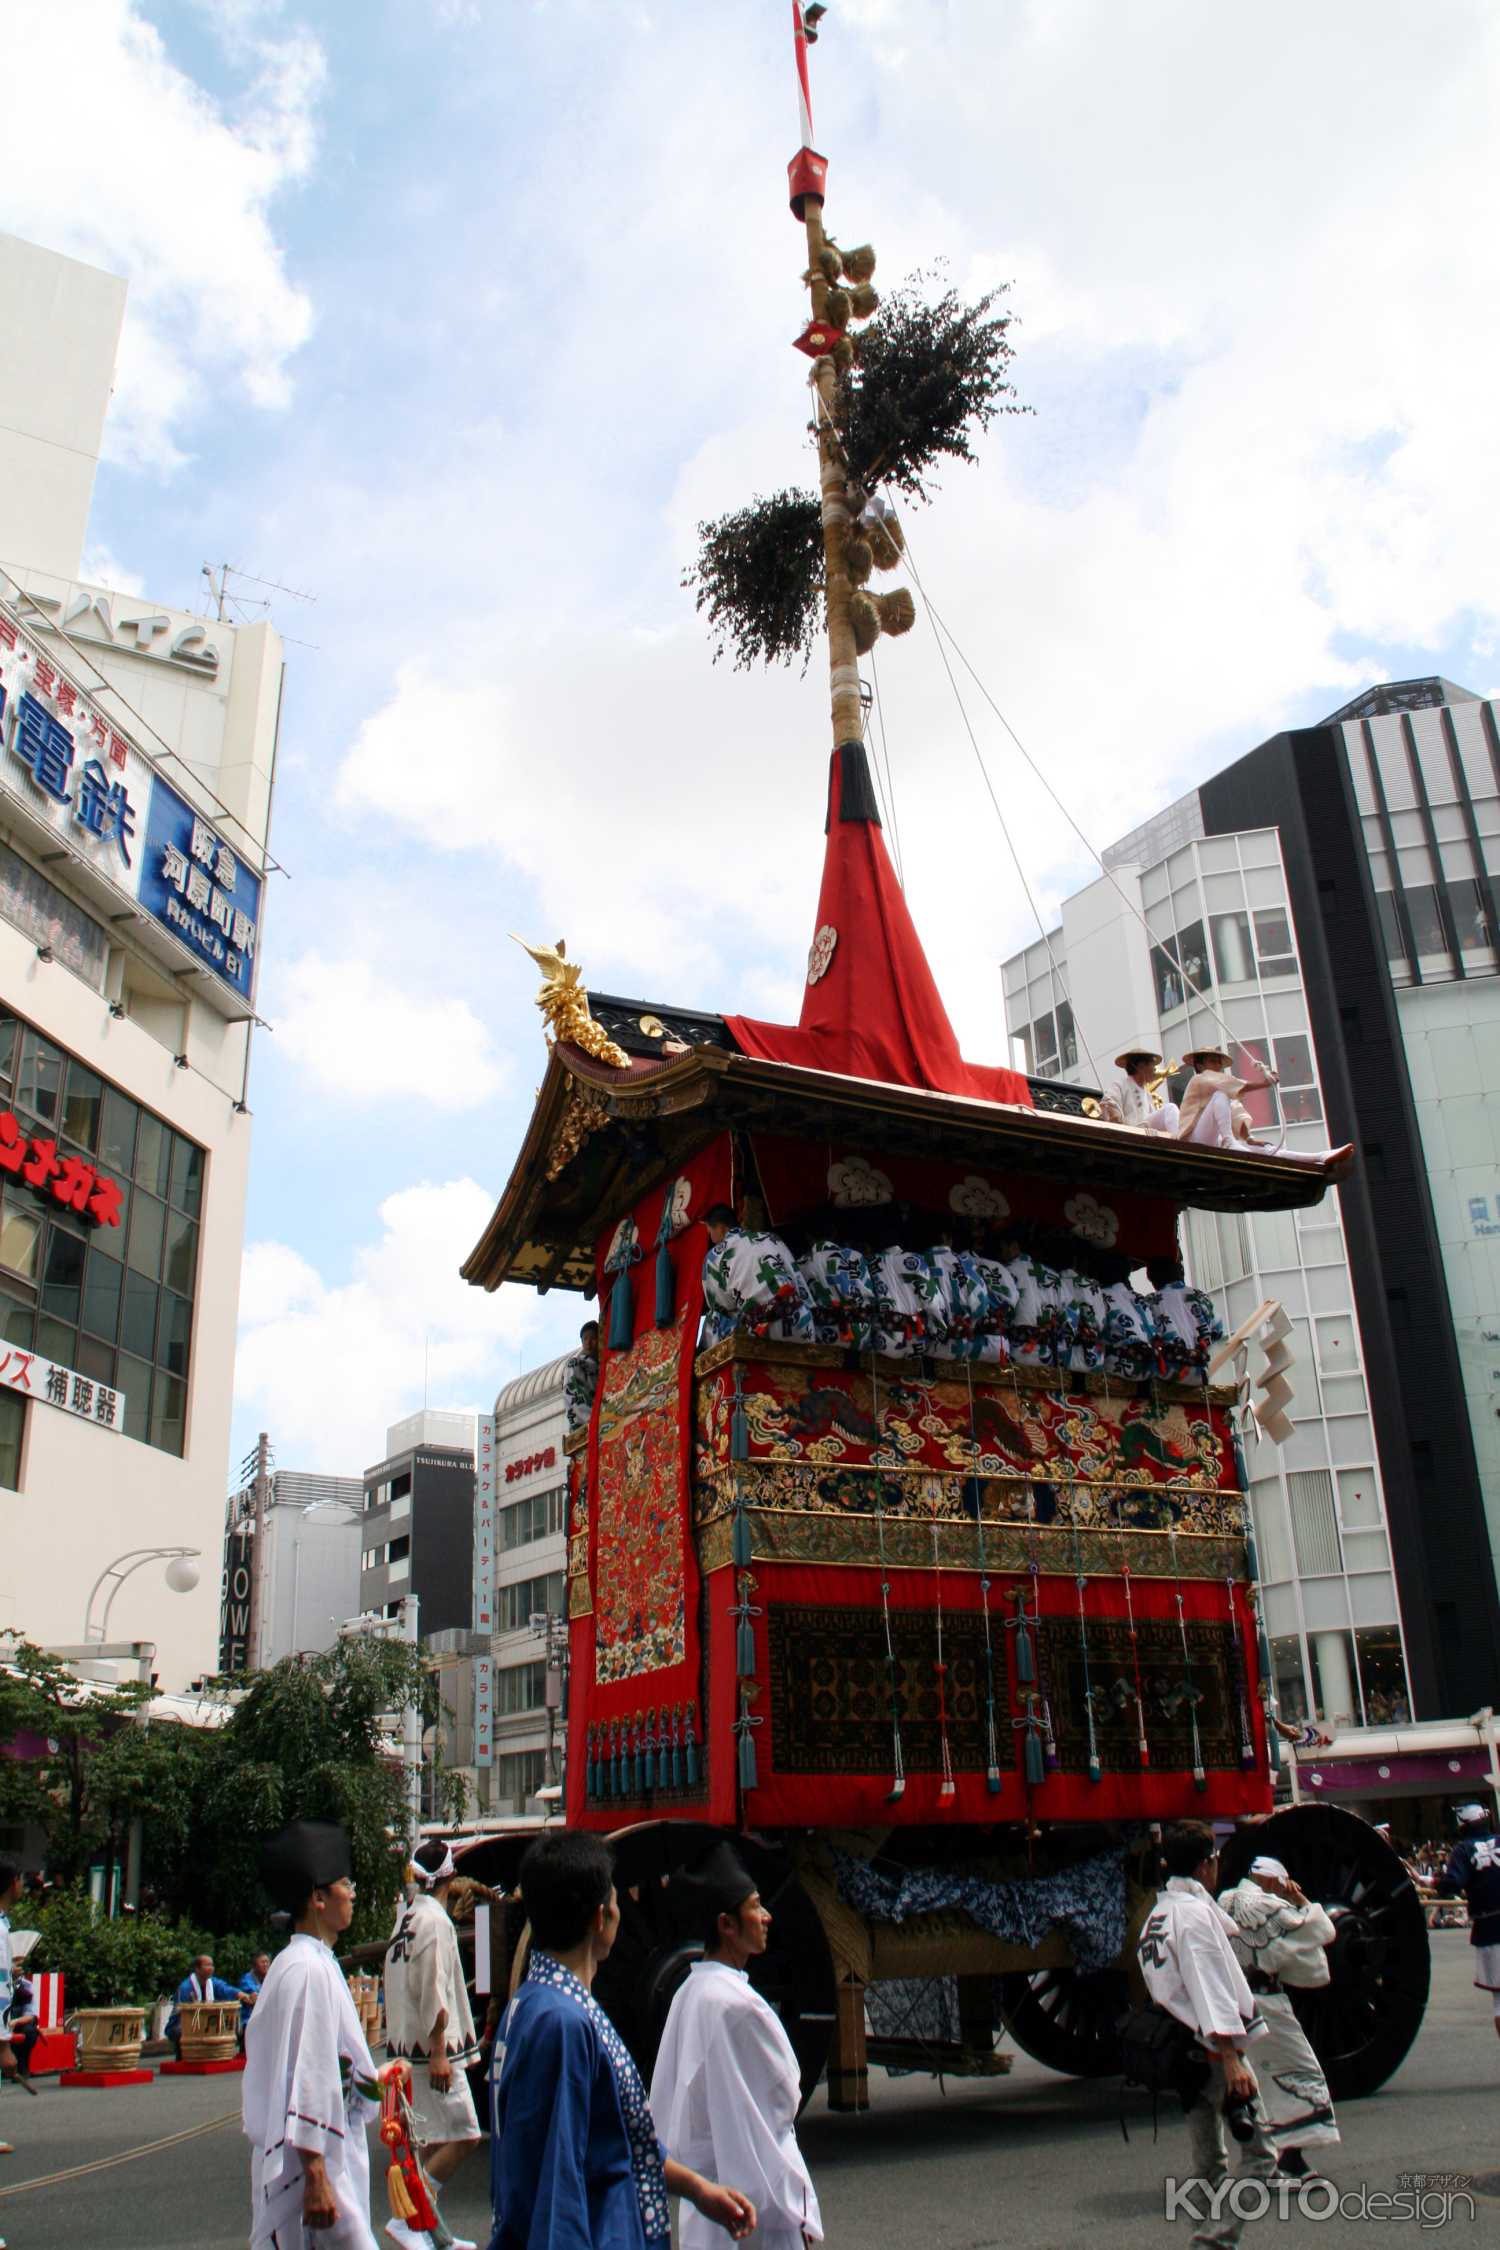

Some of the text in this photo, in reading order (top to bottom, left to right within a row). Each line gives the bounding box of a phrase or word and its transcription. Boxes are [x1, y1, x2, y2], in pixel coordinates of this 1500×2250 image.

[191, 816, 236, 893] 阪急
[162, 840, 256, 959] 河原町駅
[167, 896, 225, 961] 向かいビル
[47, 1364, 117, 1425] 補聴器
